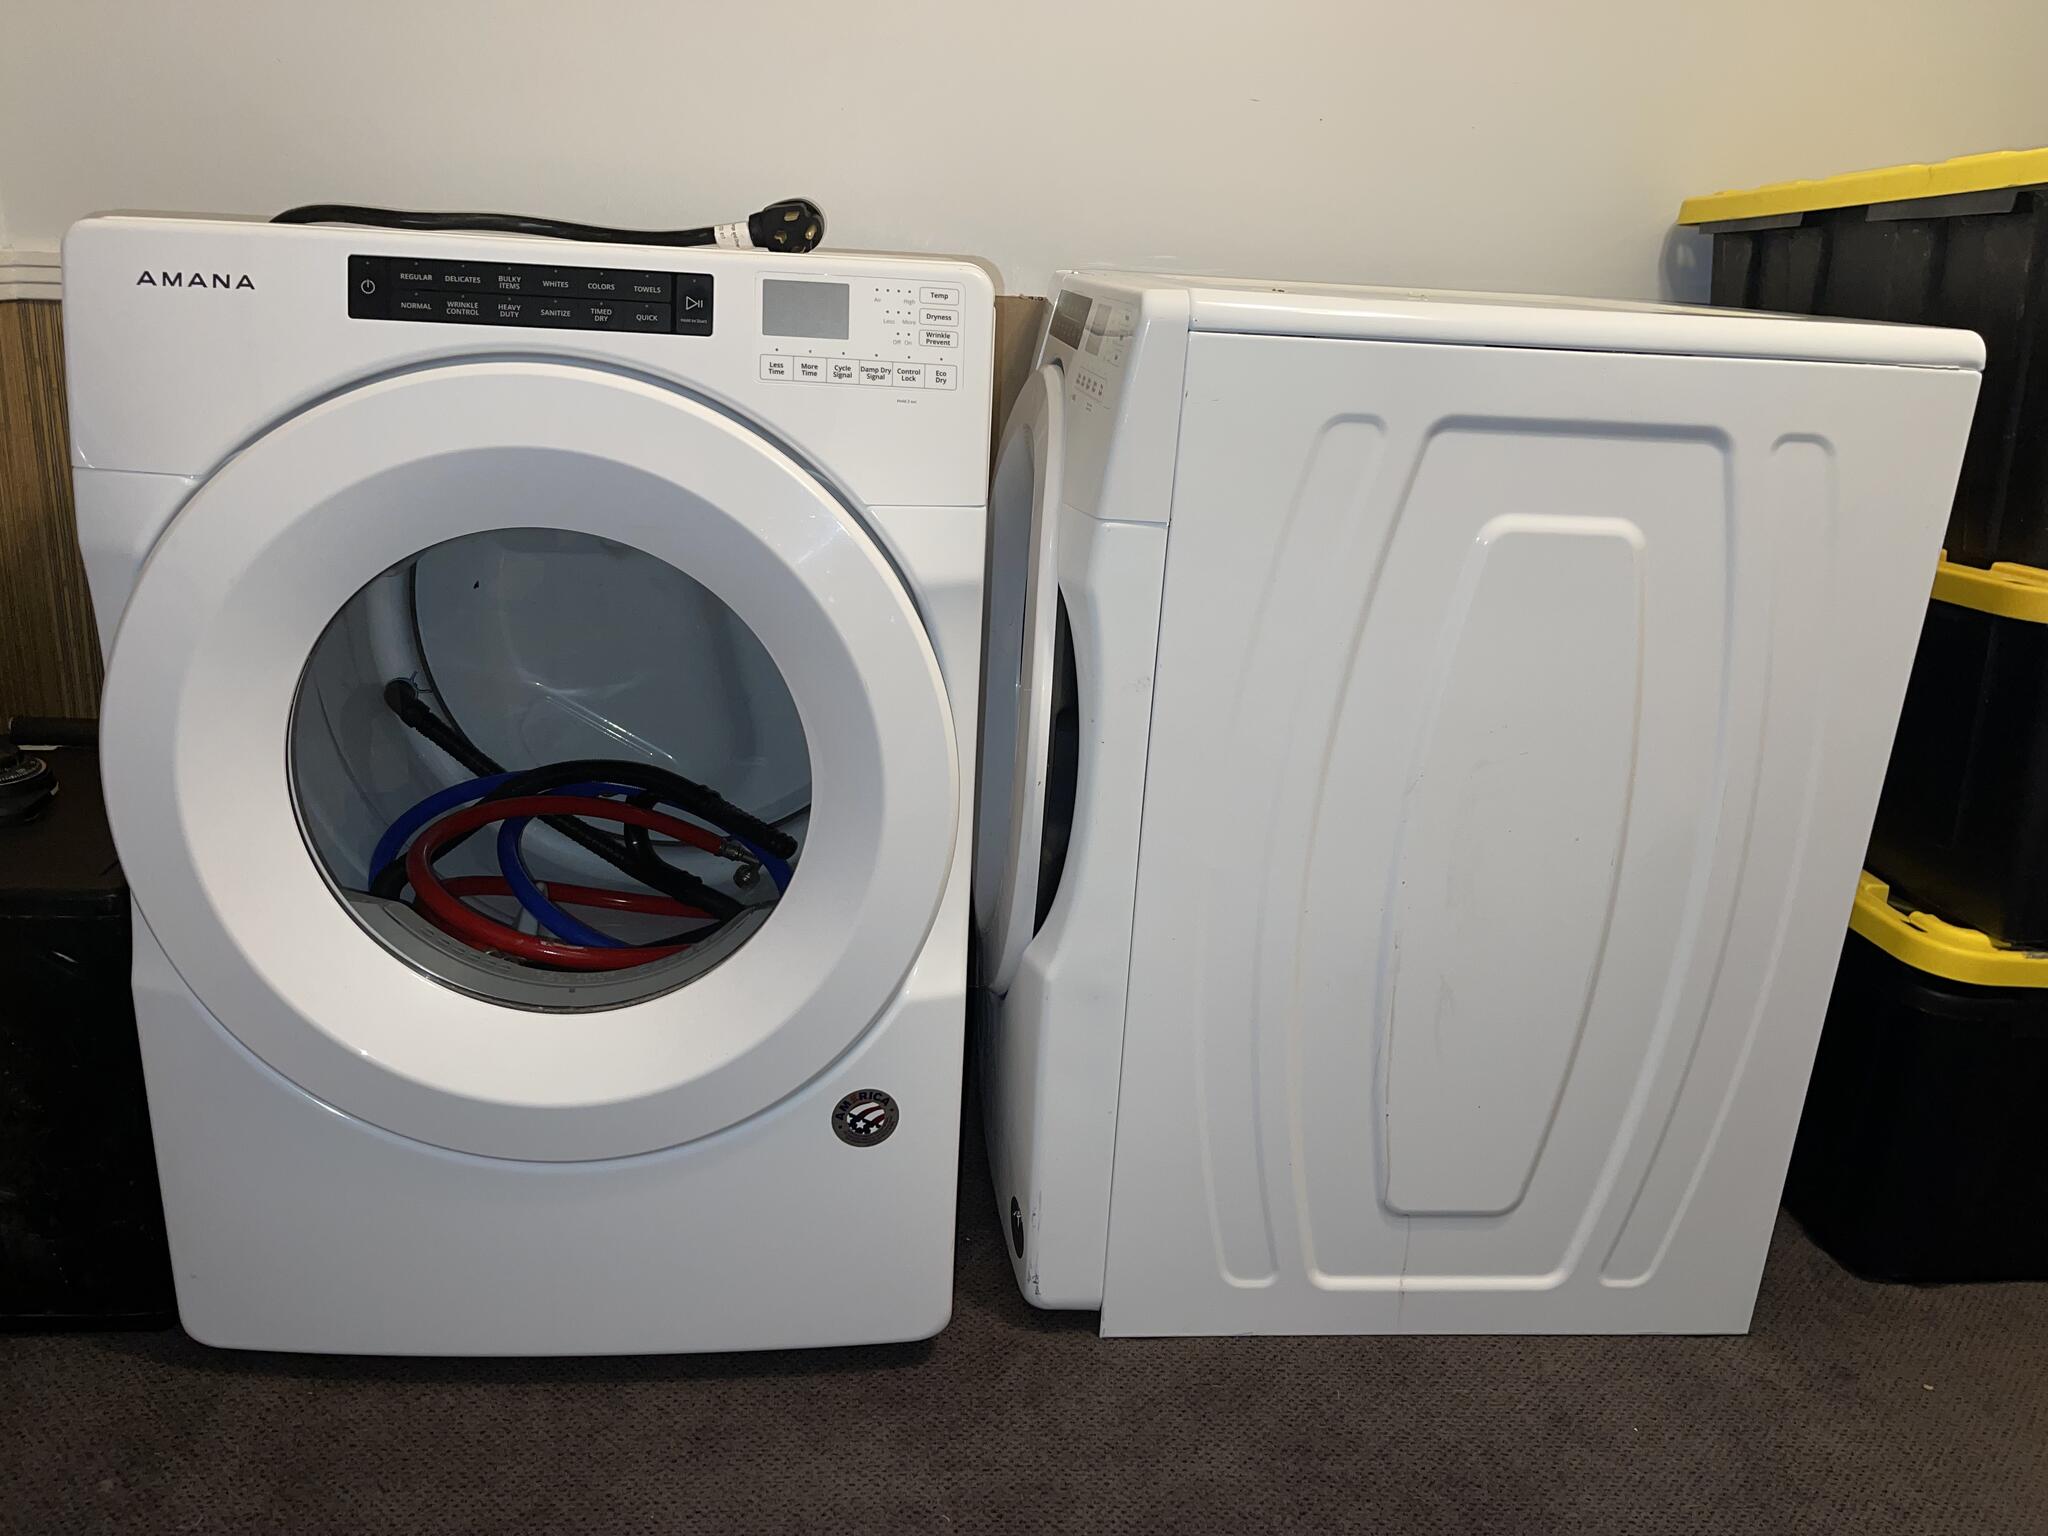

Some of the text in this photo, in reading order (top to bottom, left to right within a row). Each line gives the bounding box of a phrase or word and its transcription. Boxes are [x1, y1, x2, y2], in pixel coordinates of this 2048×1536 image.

[136, 270, 256, 290] AMANA
[400, 273, 432, 281] REGULAR
[445, 275, 481, 284] DELICATES
[498, 275, 521, 283] BULKY
[499, 282, 521, 290] ITEMS
[542, 280, 569, 288] WHITES
[587, 283, 616, 291] COLORS
[634, 285, 662, 294] TOWELS
[931, 292, 948, 300] Temp
[401, 302, 432, 310] NORMAL
[446, 301, 479, 309] WRINKLE
[498, 304, 521, 312] HEAVY
[446, 308, 479, 316] CONTROL
[540, 309, 571, 318] SANITIZE
[591, 308, 613, 316] TIMED
[594, 315, 609, 323] DRY
[636, 314, 658, 322] QUICK
[926, 313, 952, 322] Dryness
[926, 331, 951, 340] Wrinkle
[769, 361, 784, 369] Less
[801, 363, 819, 371] More
[833, 364, 852, 374] Cycle
[768, 367, 785, 376] Time
[801, 370, 818, 378] Time
[860, 365, 892, 376] Damp Dry
[896, 368, 921, 377] Control
[935, 370, 947, 378] Eco
[832, 371, 853, 380] Signal
[866, 373, 886, 382] Signal
[901, 375, 917, 383] Lock
[935, 376, 947, 386] Dry
